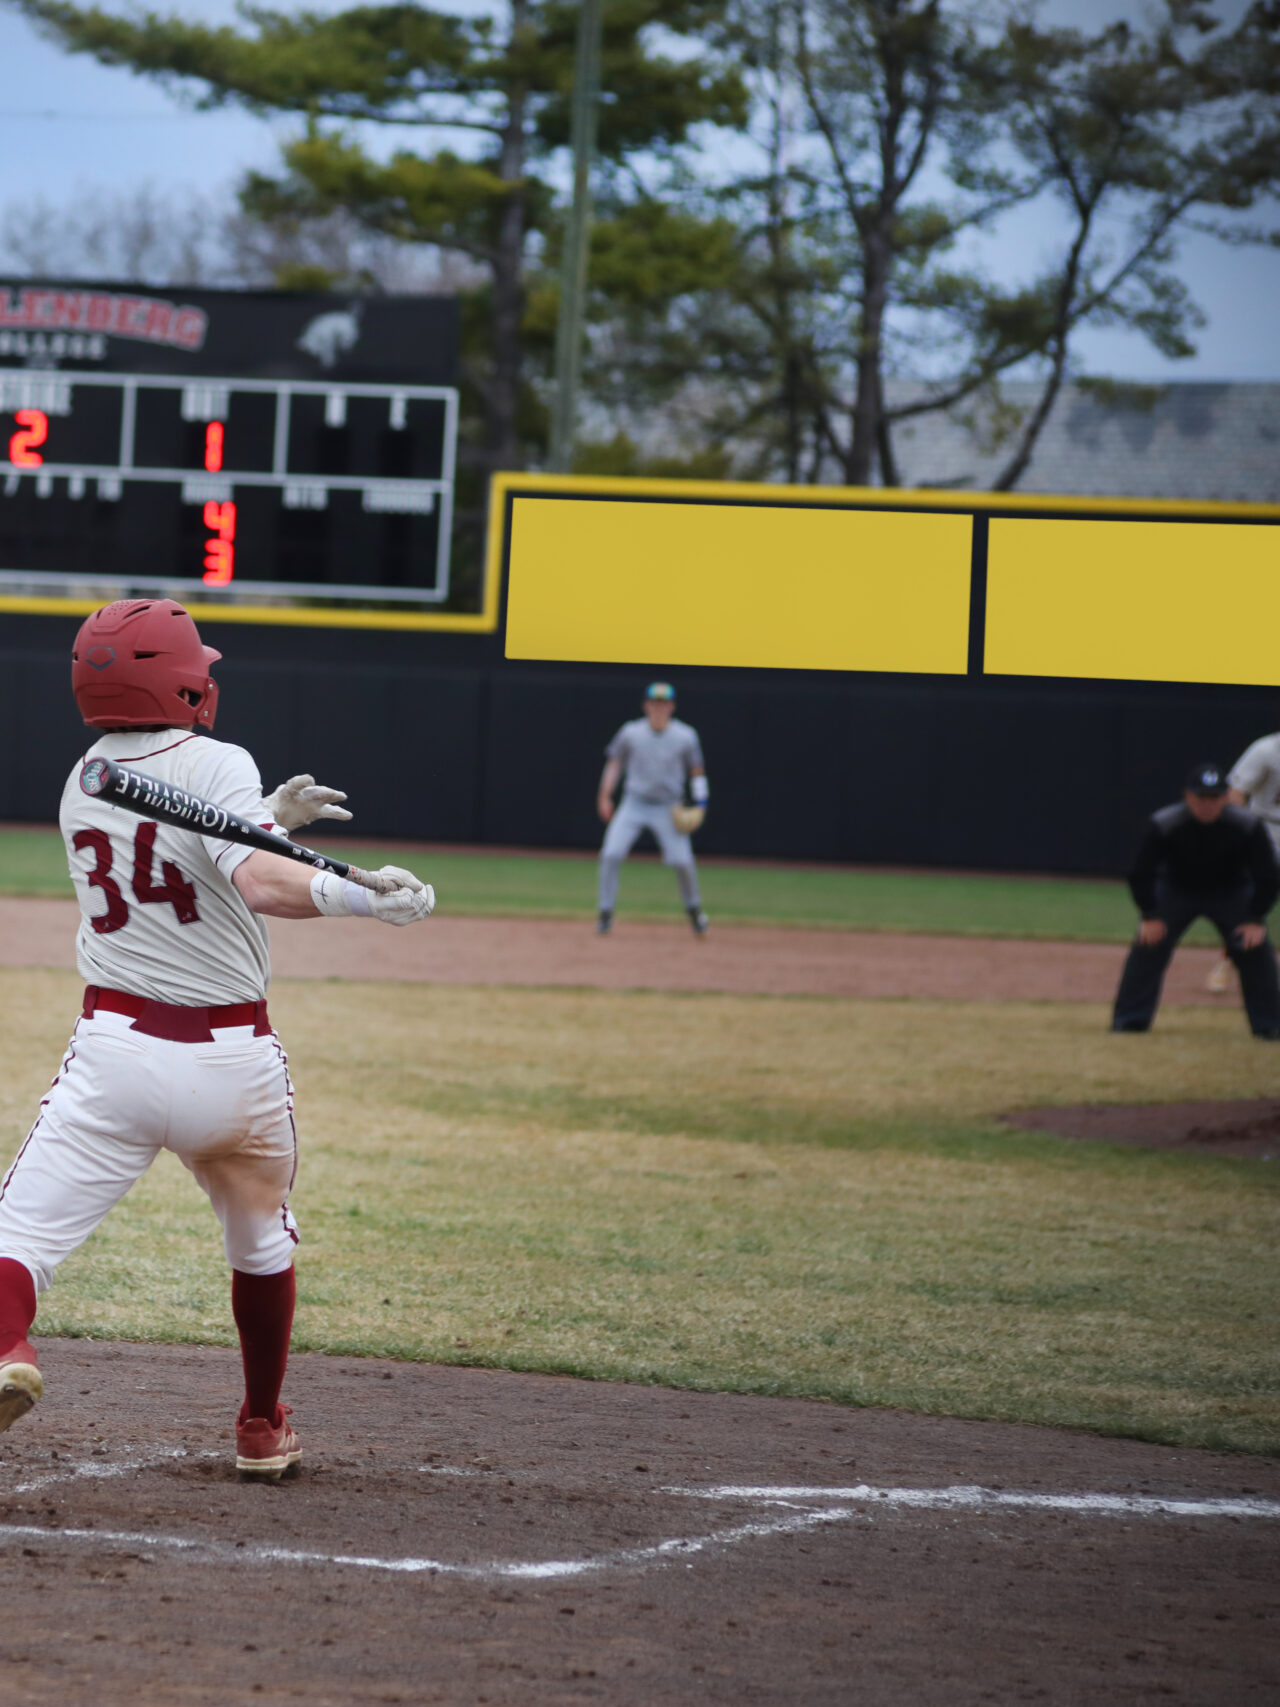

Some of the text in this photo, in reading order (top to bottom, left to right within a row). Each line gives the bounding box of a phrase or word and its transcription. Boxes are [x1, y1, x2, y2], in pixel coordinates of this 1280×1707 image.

[9, 409, 48, 468] 2
[205, 421, 224, 472] 1
[204, 500, 236, 542] 4
[203, 538, 235, 587] 3
[114, 767, 228, 833] LOUISVILLE
[72, 820, 202, 936] 34
